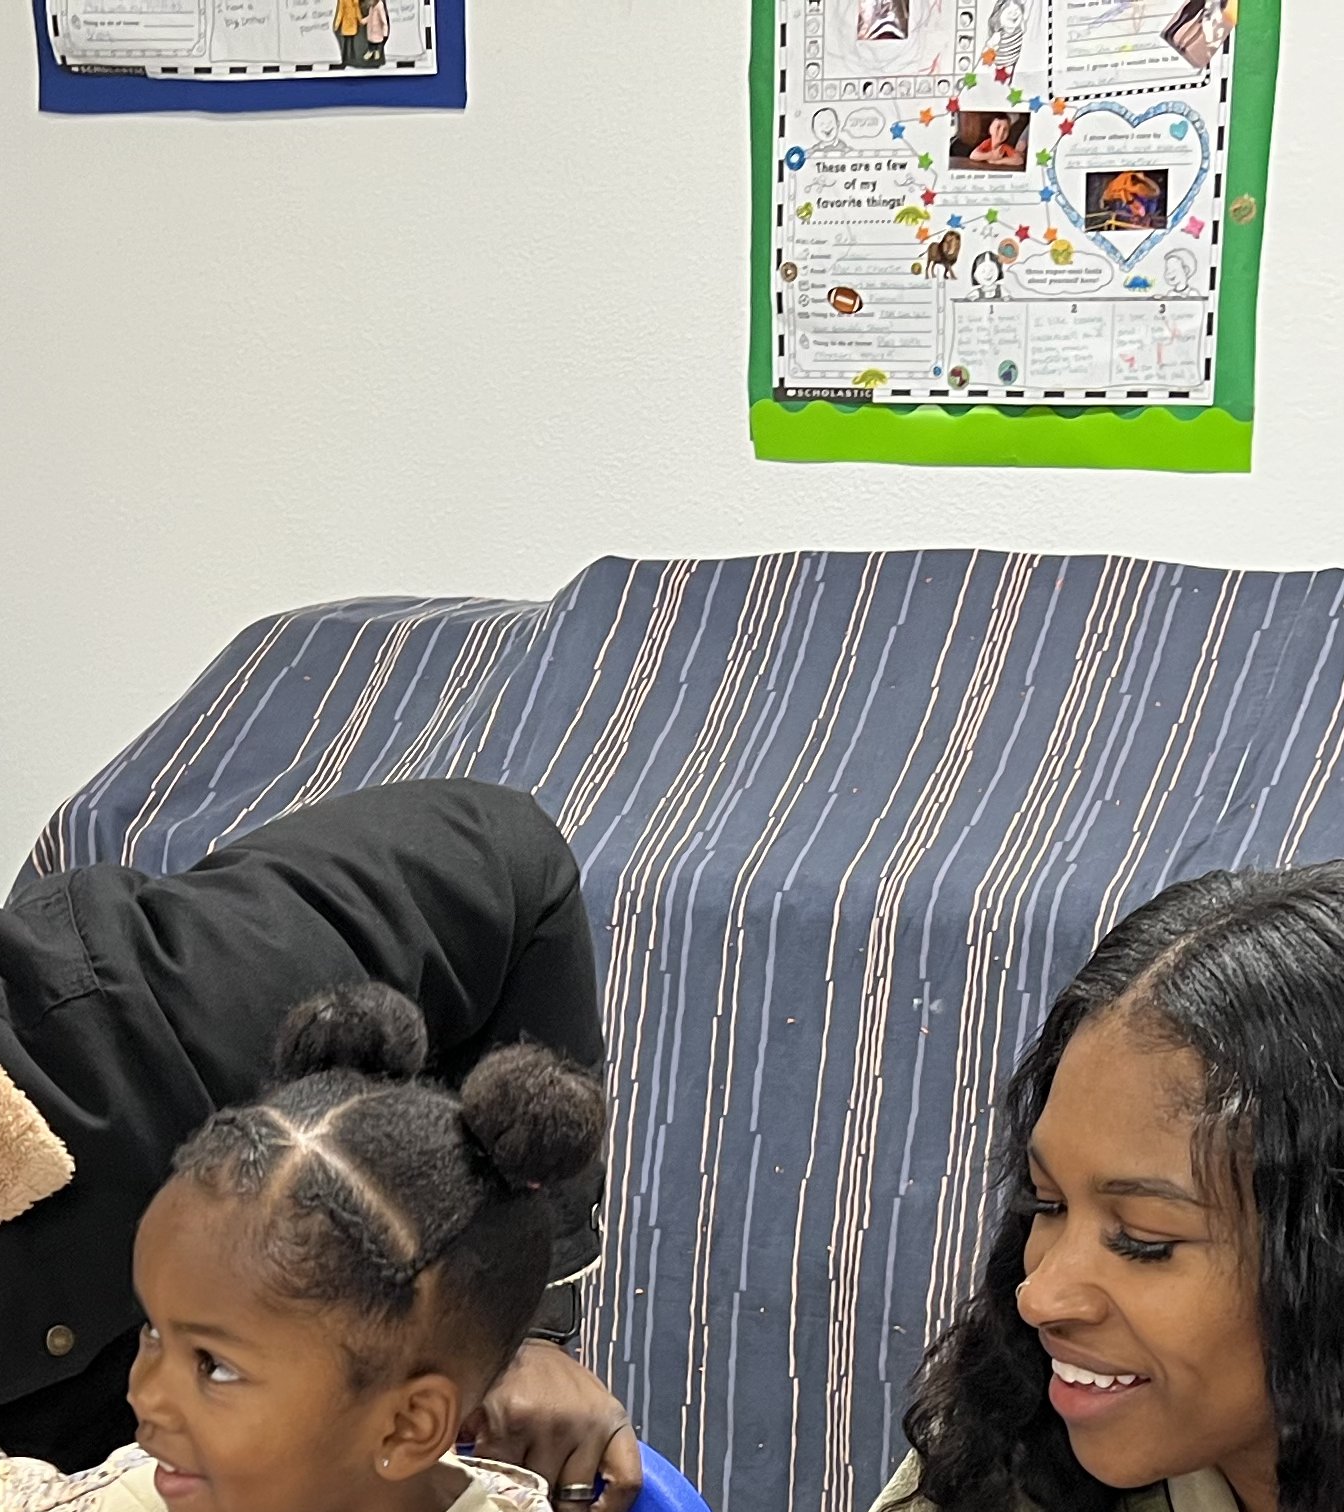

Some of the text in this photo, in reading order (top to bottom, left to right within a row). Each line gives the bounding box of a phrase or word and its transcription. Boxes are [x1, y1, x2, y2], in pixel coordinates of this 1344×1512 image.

[816, 159, 908, 174] These are a few
[844, 179, 877, 192] of my
[816, 195, 906, 210] favorite things!
[797, 388, 872, 399] SCHOLASTIC
